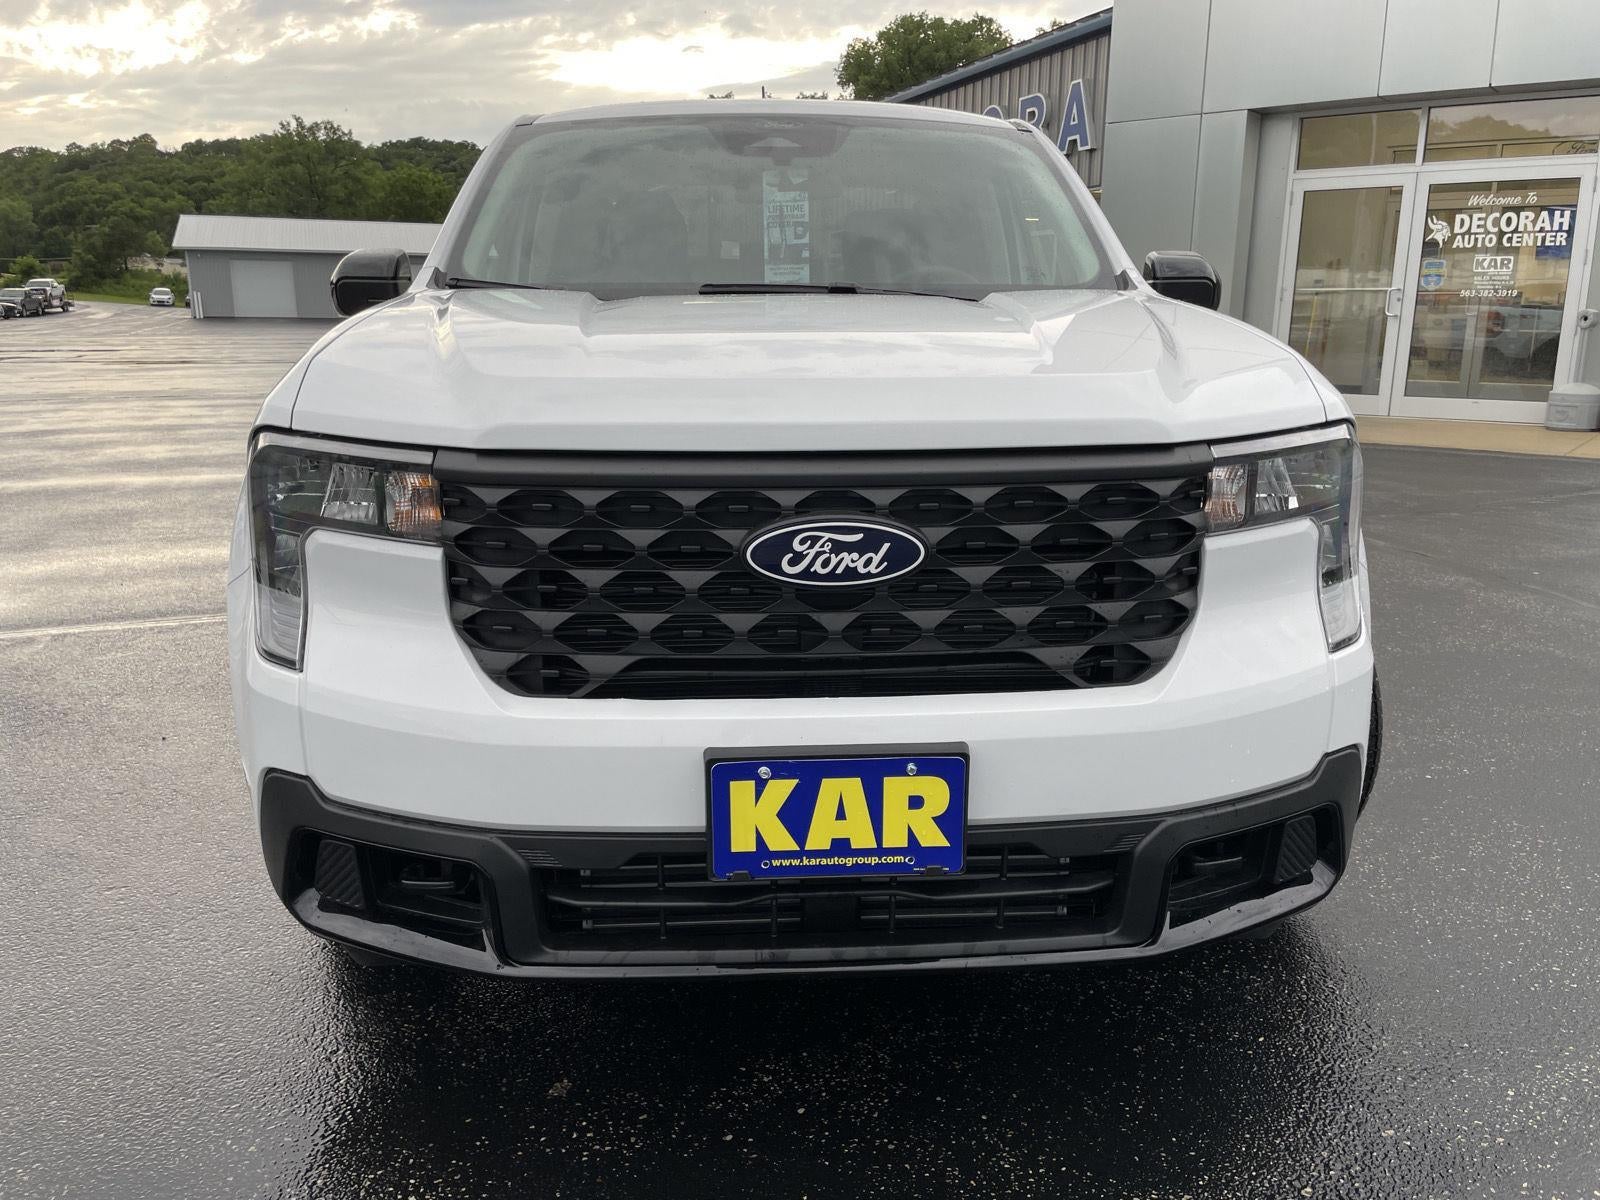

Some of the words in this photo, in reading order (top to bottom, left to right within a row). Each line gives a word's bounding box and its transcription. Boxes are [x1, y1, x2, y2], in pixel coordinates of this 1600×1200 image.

[982, 79, 1091, 155] RA
[1468, 193, 1522, 206] Welcome
[1524, 191, 1538, 204] To
[1453, 210, 1571, 234] DECORAH
[1452, 234, 1497, 249] AUTO
[1502, 232, 1568, 247] CENTER
[1474, 257, 1512, 271] KAR
[1460, 289, 1518, 297] 563-382-3919
[781, 531, 891, 575] Ford
[729, 775, 951, 853] KAR
[771, 855, 905, 868] www.karautogroup.com
